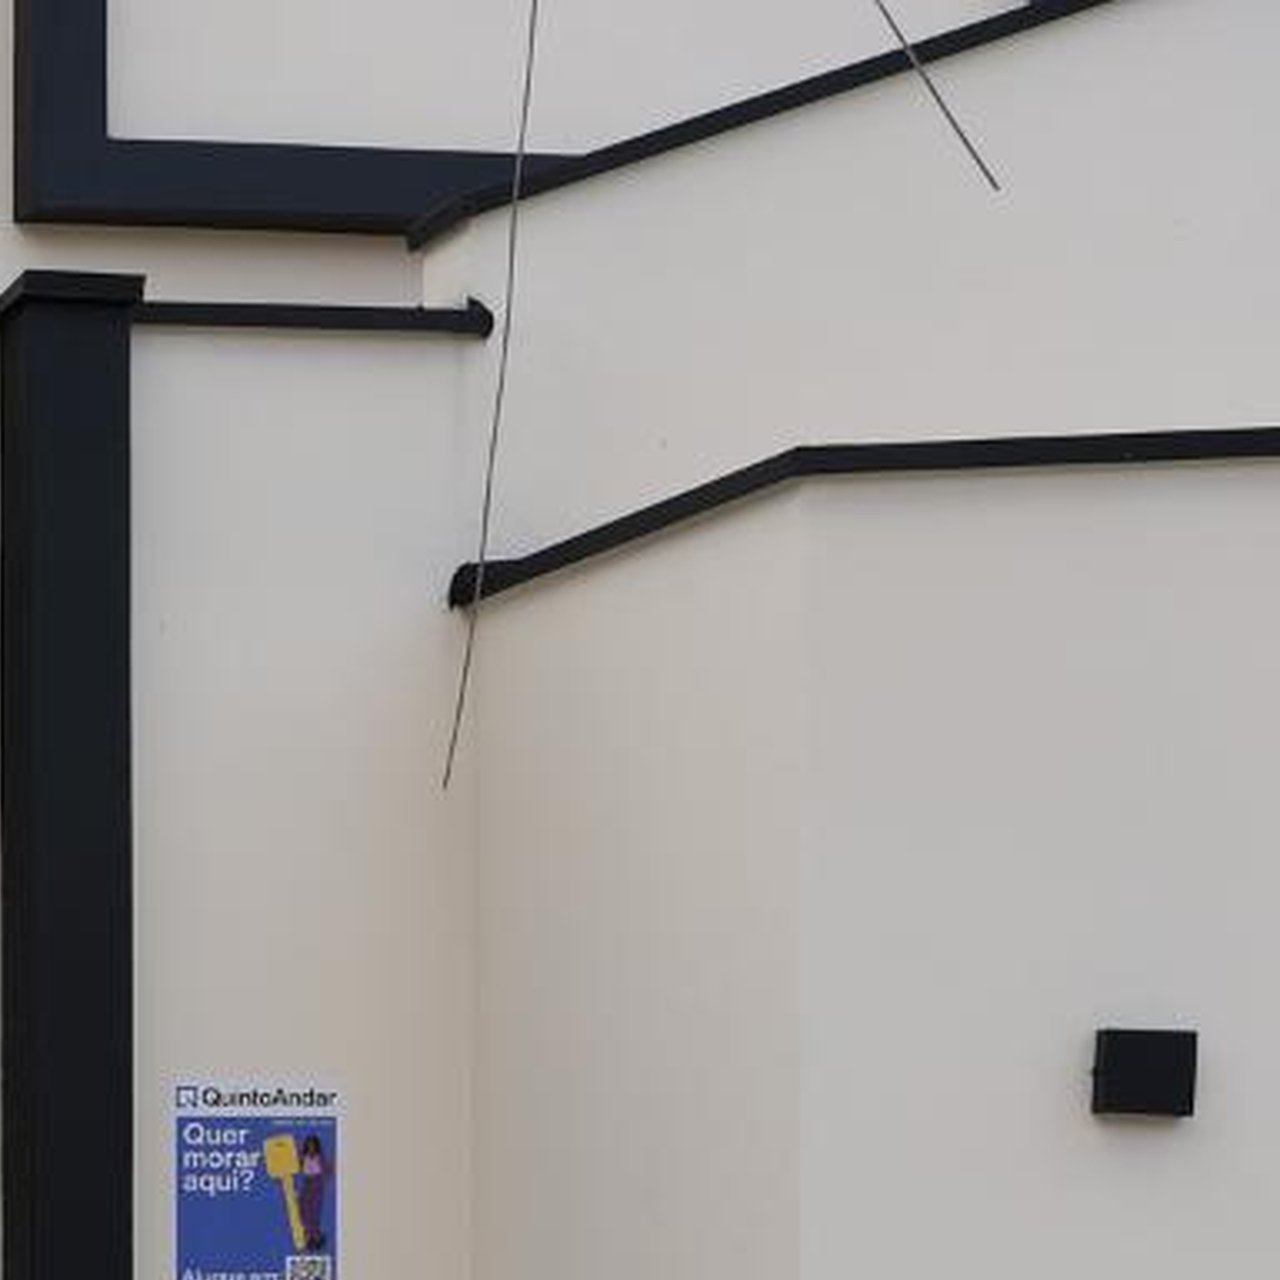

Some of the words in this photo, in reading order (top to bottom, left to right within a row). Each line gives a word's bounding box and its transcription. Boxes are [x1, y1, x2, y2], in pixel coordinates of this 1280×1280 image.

[202, 1087, 337, 1107] QuintoAndar
[183, 1122, 249, 1145] Quer
[183, 1151, 261, 1168] morar
[183, 1169, 254, 1196] aqui?
